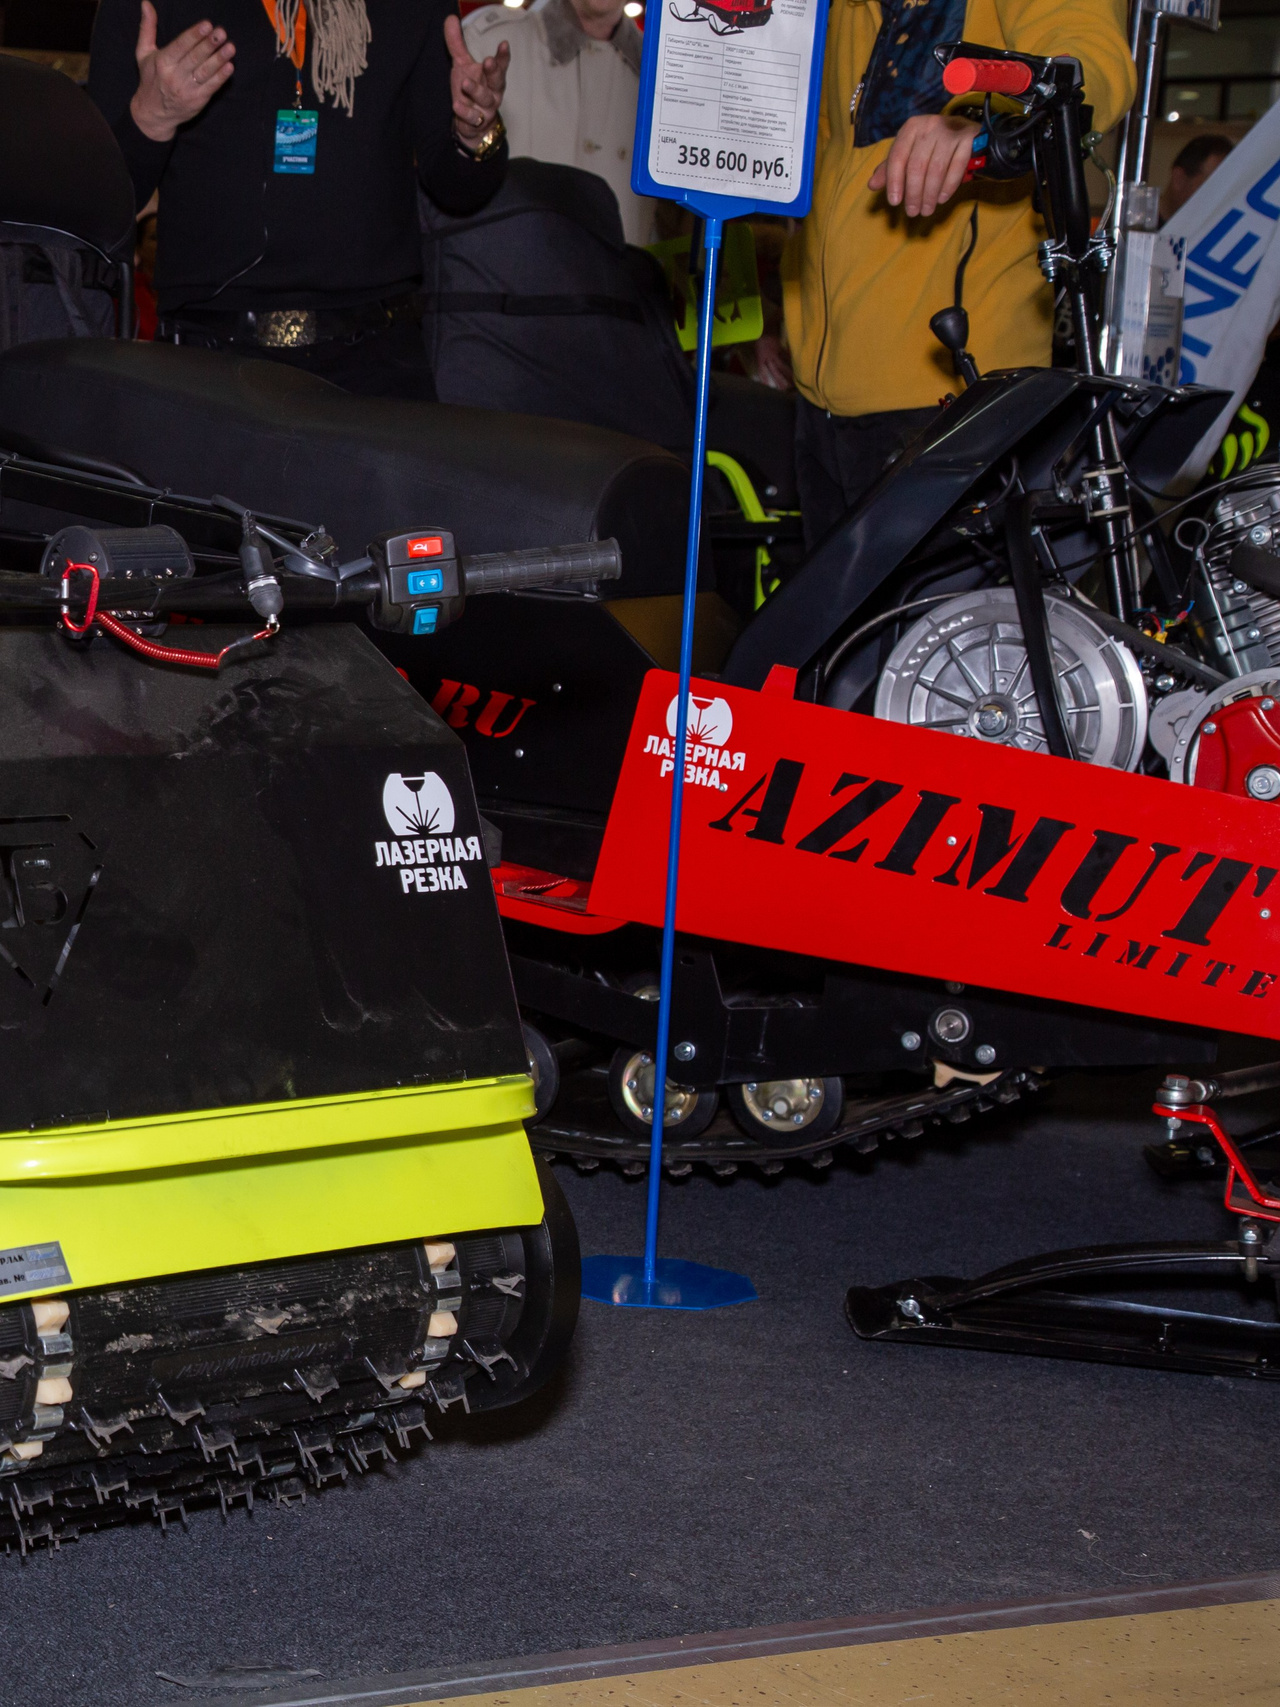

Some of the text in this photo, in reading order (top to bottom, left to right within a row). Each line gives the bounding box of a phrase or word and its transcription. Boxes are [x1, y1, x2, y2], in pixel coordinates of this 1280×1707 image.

[661, 136, 677, 144] ЦЕНА
[677, 144, 790, 181] 358 600 руб.
[660, 758, 721, 789] РЗКА
[374, 836, 482, 867] ЛАЗЕРНАЯ
[708, 757, 1279, 946] AZIMUT
[400, 865, 468, 894] РЕЗКА
